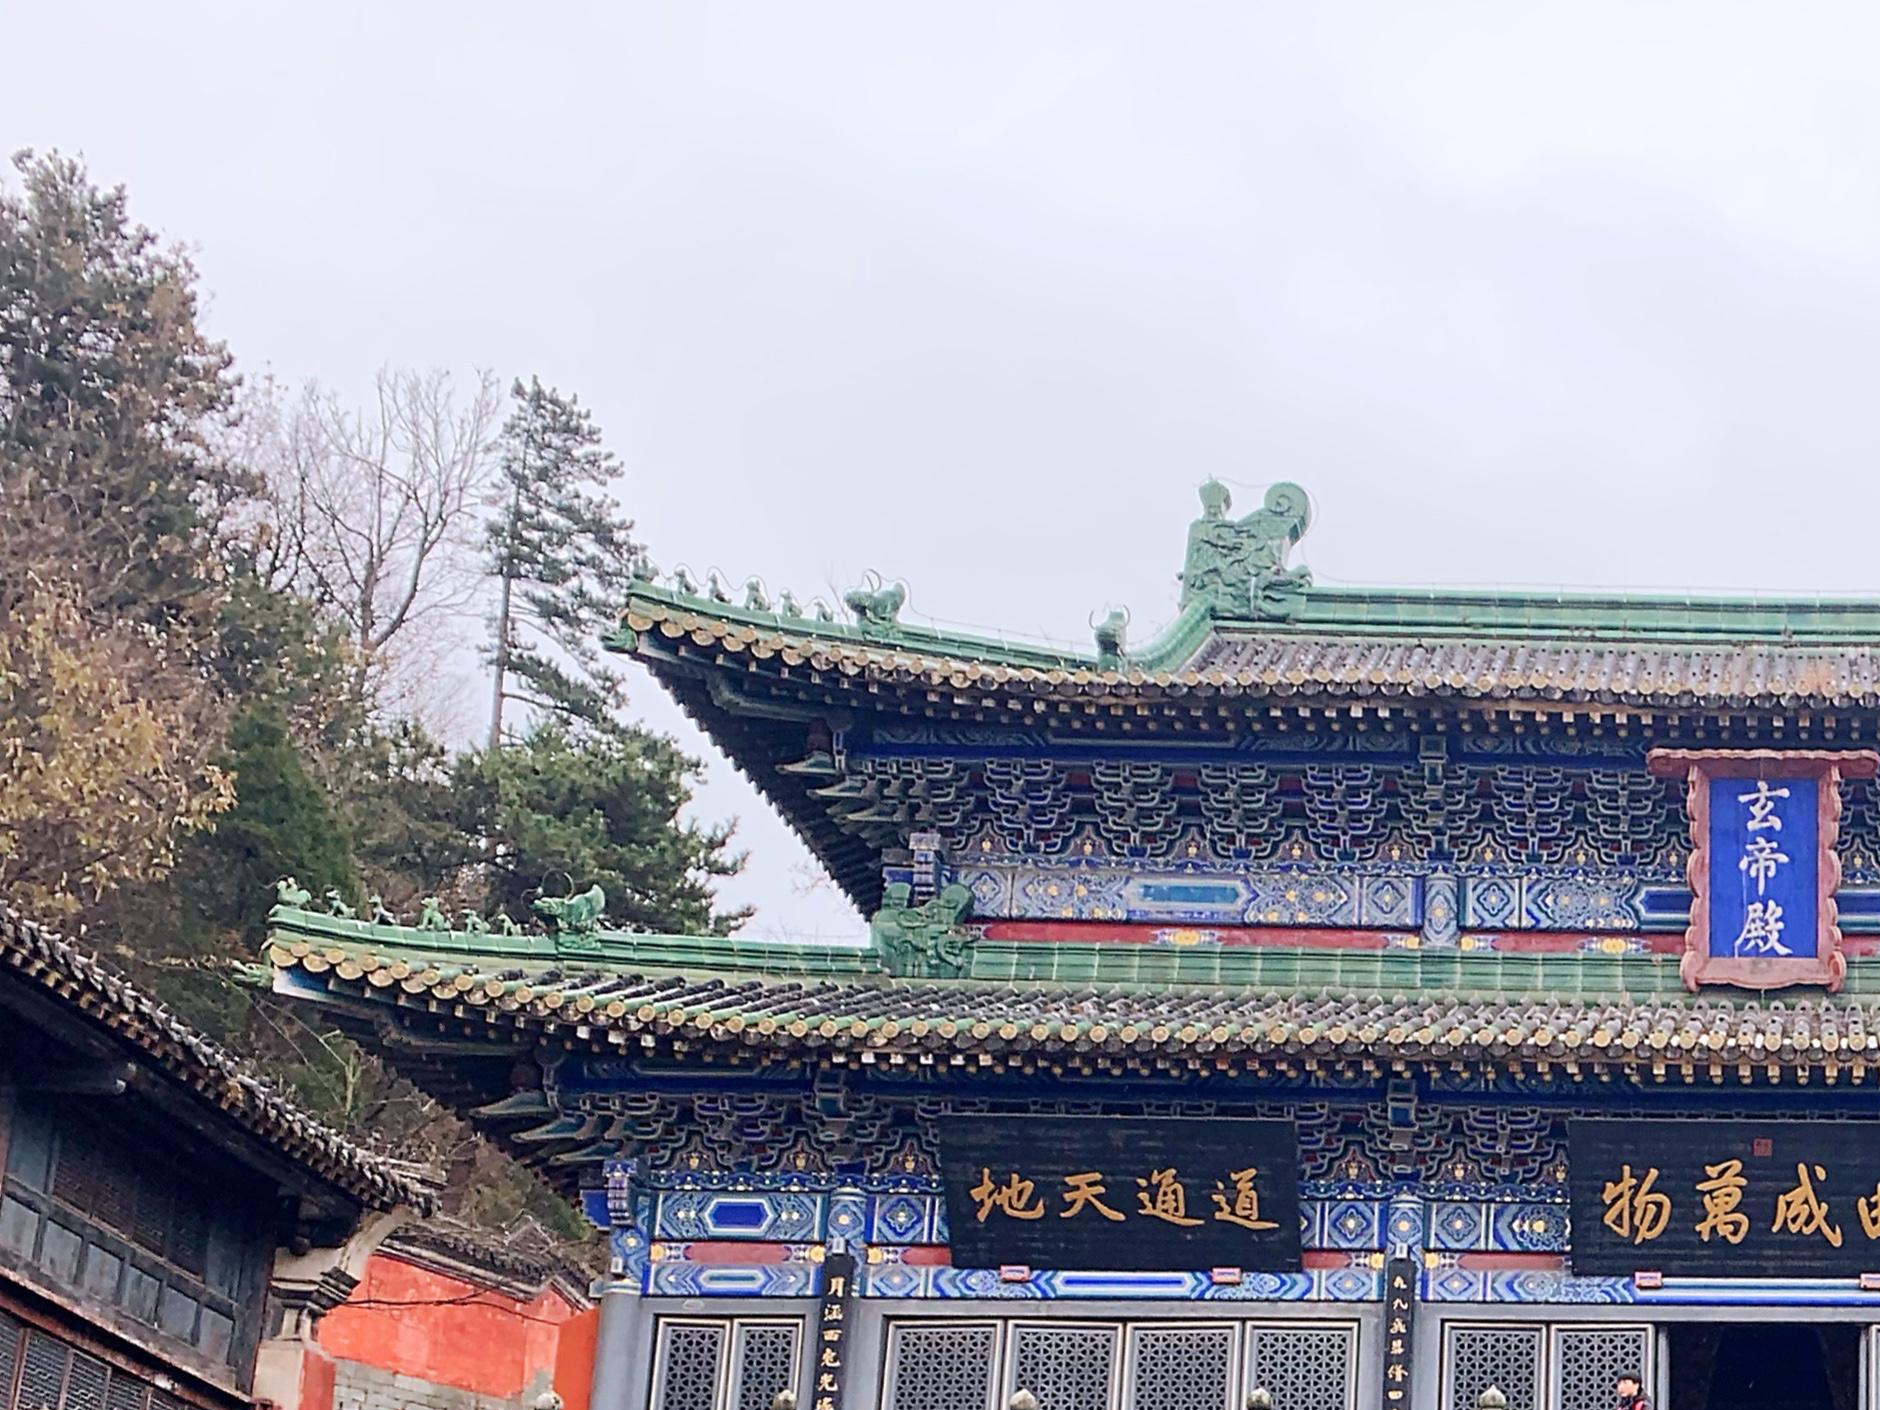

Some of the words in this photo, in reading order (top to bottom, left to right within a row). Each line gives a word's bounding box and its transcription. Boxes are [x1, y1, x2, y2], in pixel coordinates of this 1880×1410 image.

[1737, 780, 1795, 957] 玄帝殿
[969, 1166, 1280, 1231] 道通天地
